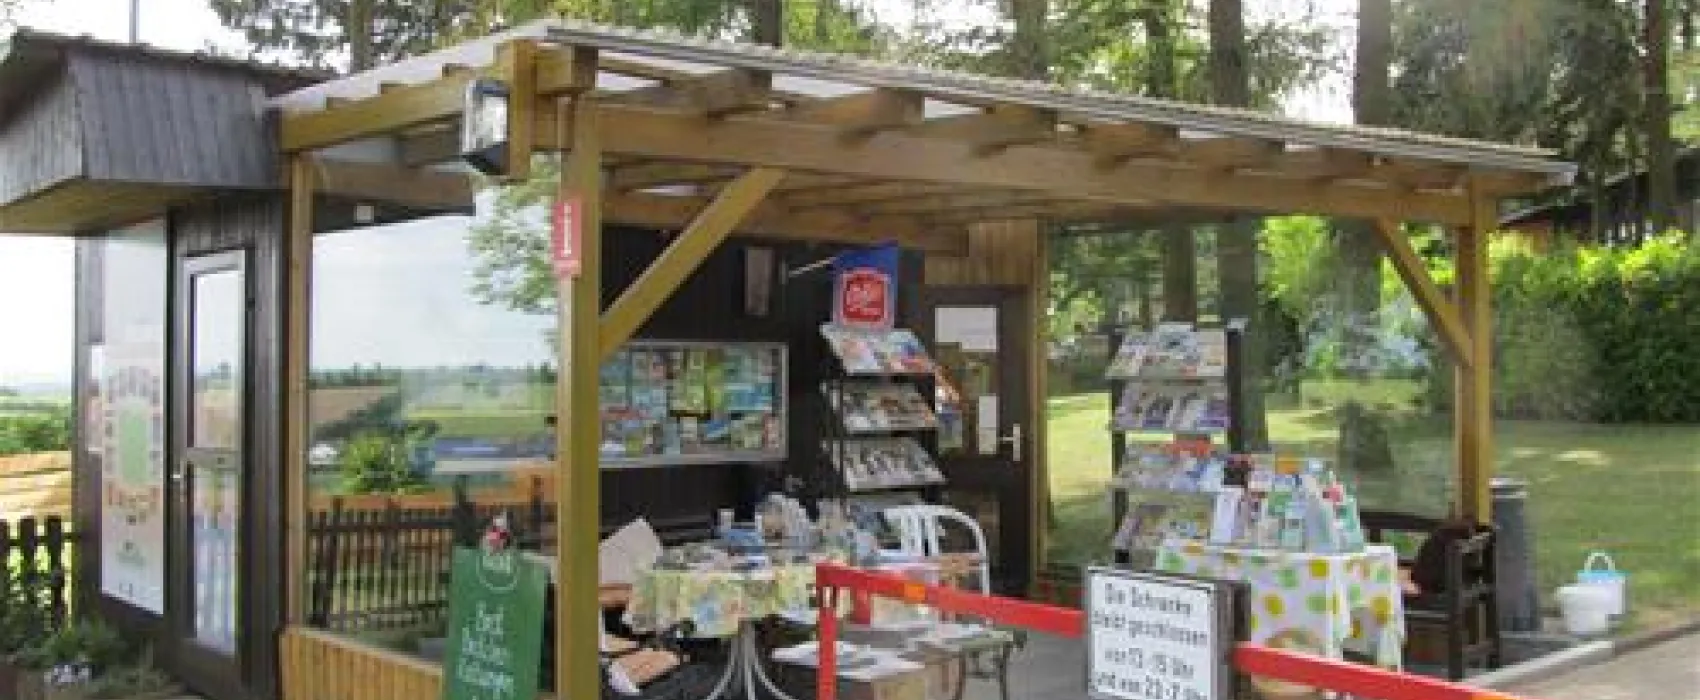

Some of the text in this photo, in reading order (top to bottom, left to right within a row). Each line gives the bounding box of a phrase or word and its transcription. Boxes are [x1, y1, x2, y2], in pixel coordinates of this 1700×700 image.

[1104, 582, 1191, 615] Die Schranke
[1172, 657, 1195, 680] Uhr
